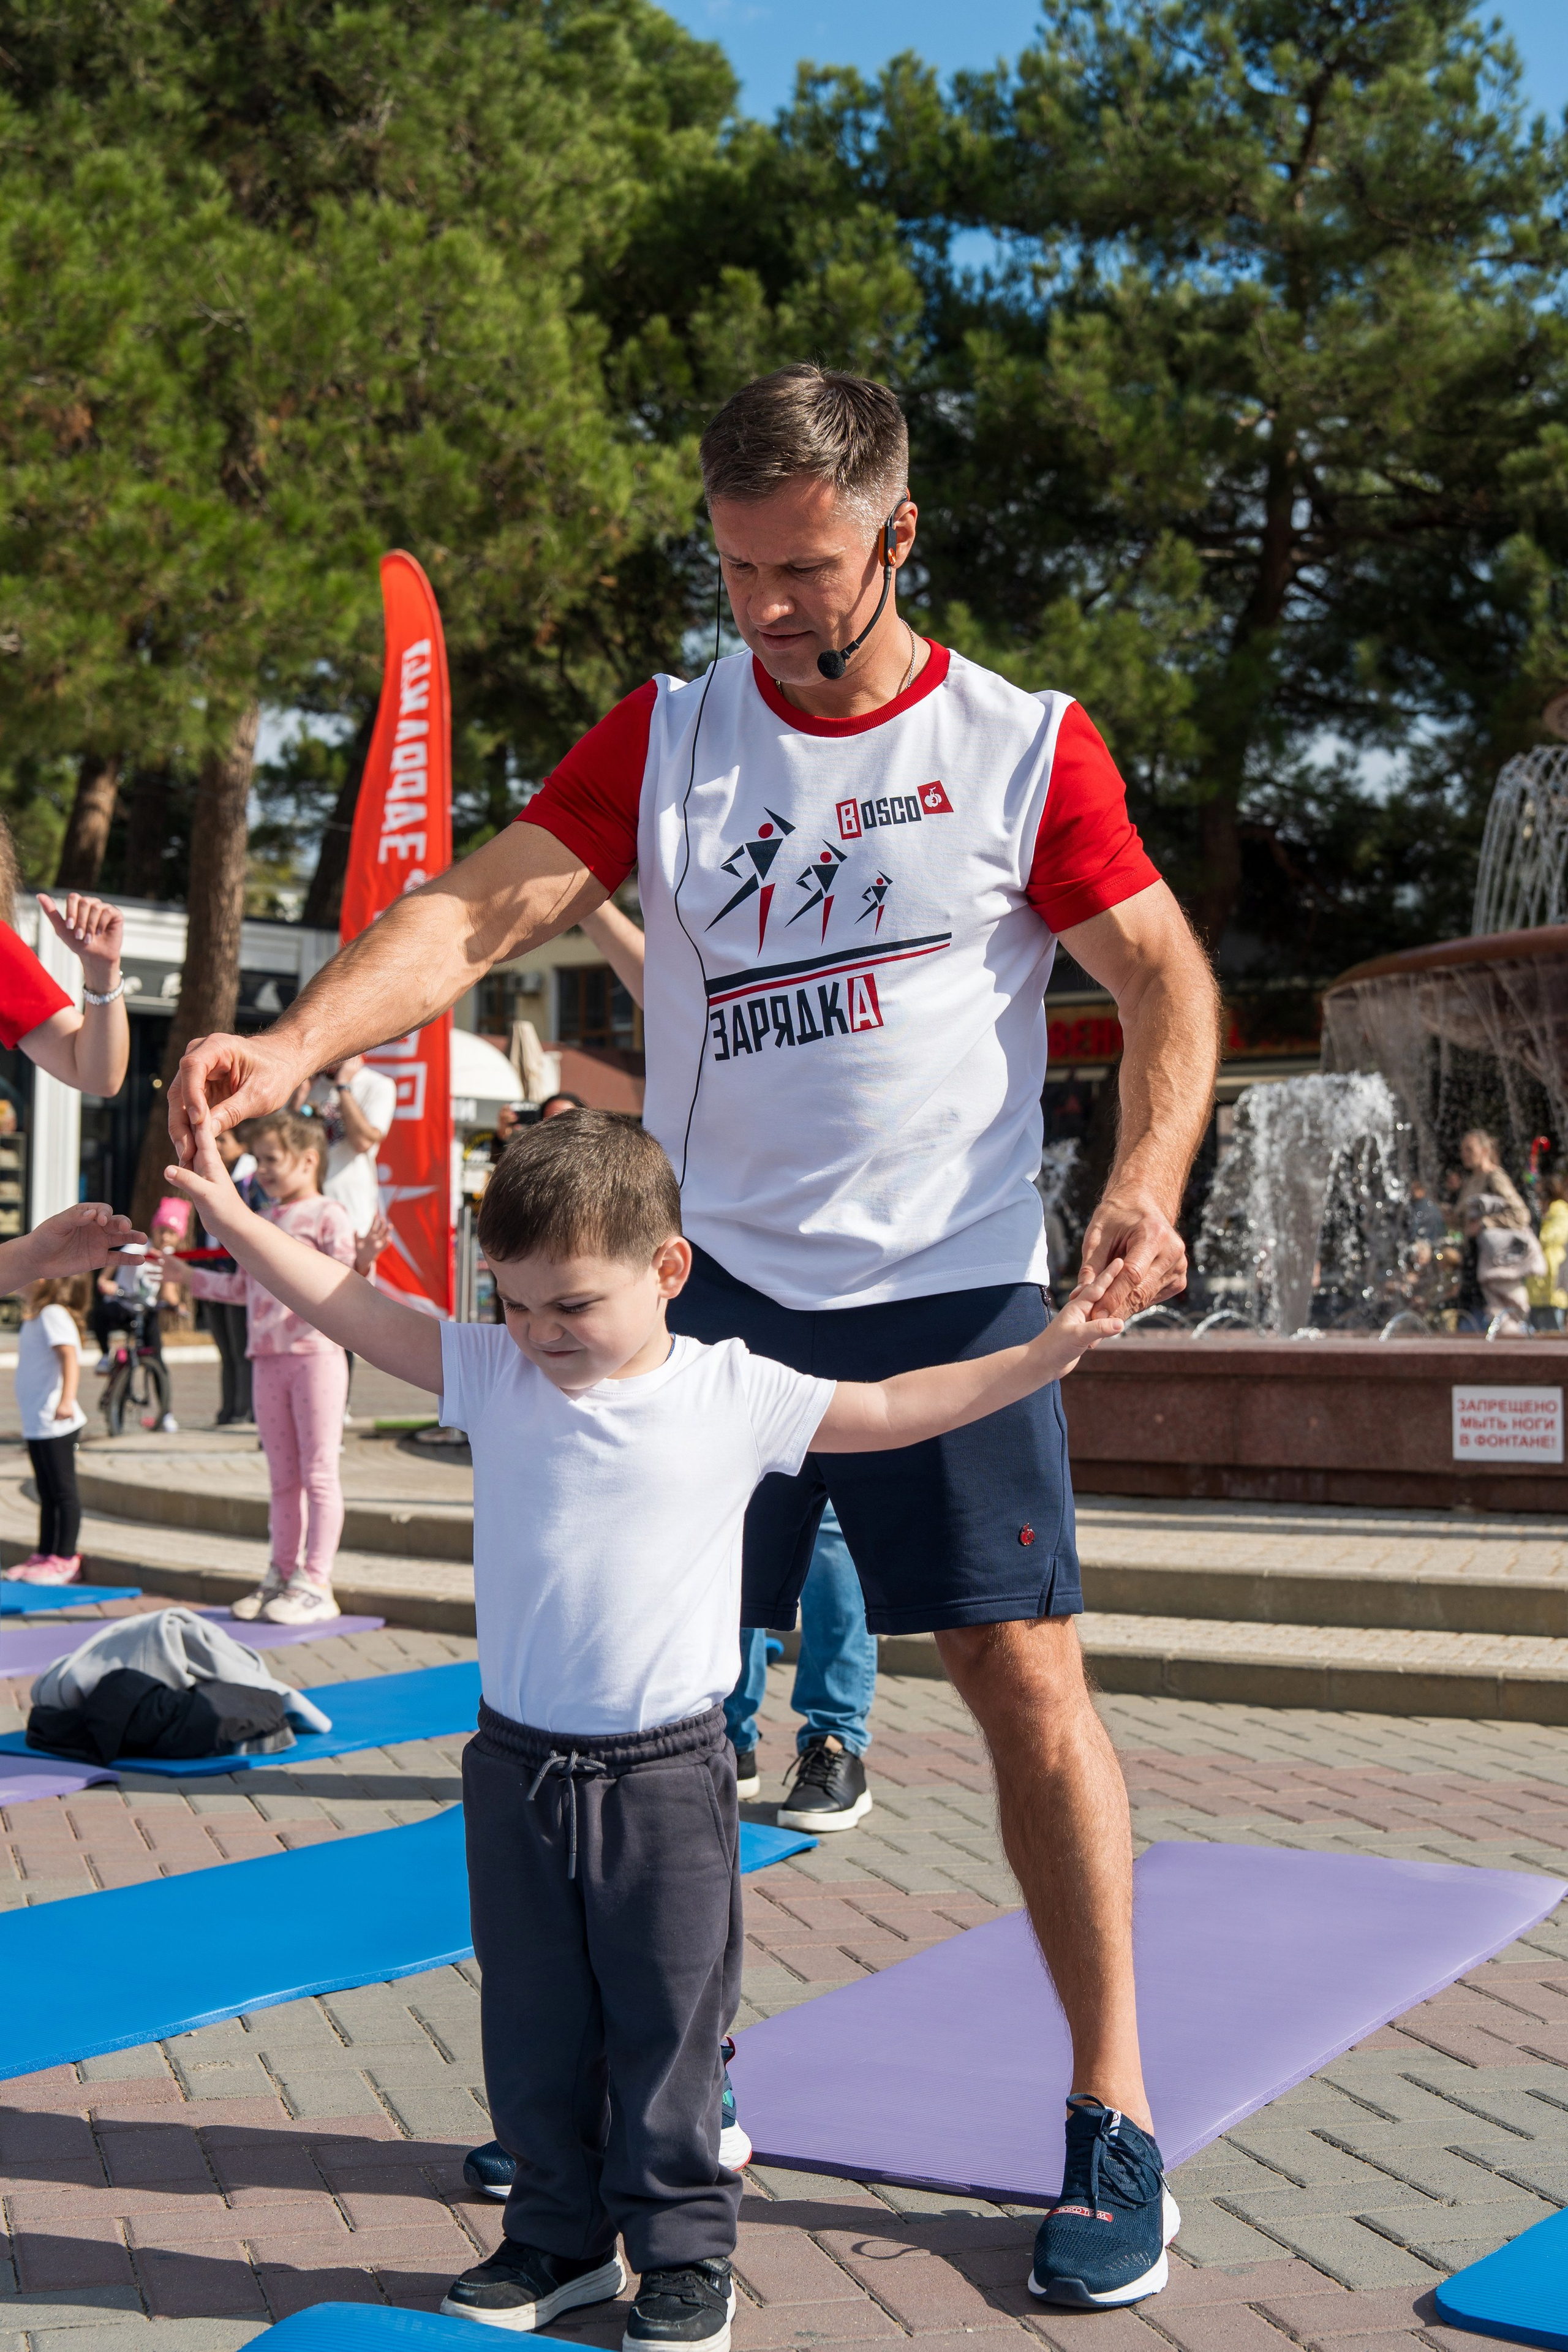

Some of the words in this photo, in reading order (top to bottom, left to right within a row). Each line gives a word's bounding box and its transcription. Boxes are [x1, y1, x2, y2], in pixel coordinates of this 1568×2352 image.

[836, 796, 922, 839] BOSCO
[710, 973, 883, 1061] ЗАРЯДКА
[1457, 1398, 1558, 1414] ЗАПРЕЩЕНО
[1460, 1417, 1508, 1430] МЫТЬ
[1512, 1417, 1556, 1431] НОГИ
[1459, 1433, 1470, 1447] В
[1474, 1434, 1556, 1449] ФОНТАНЕ!
